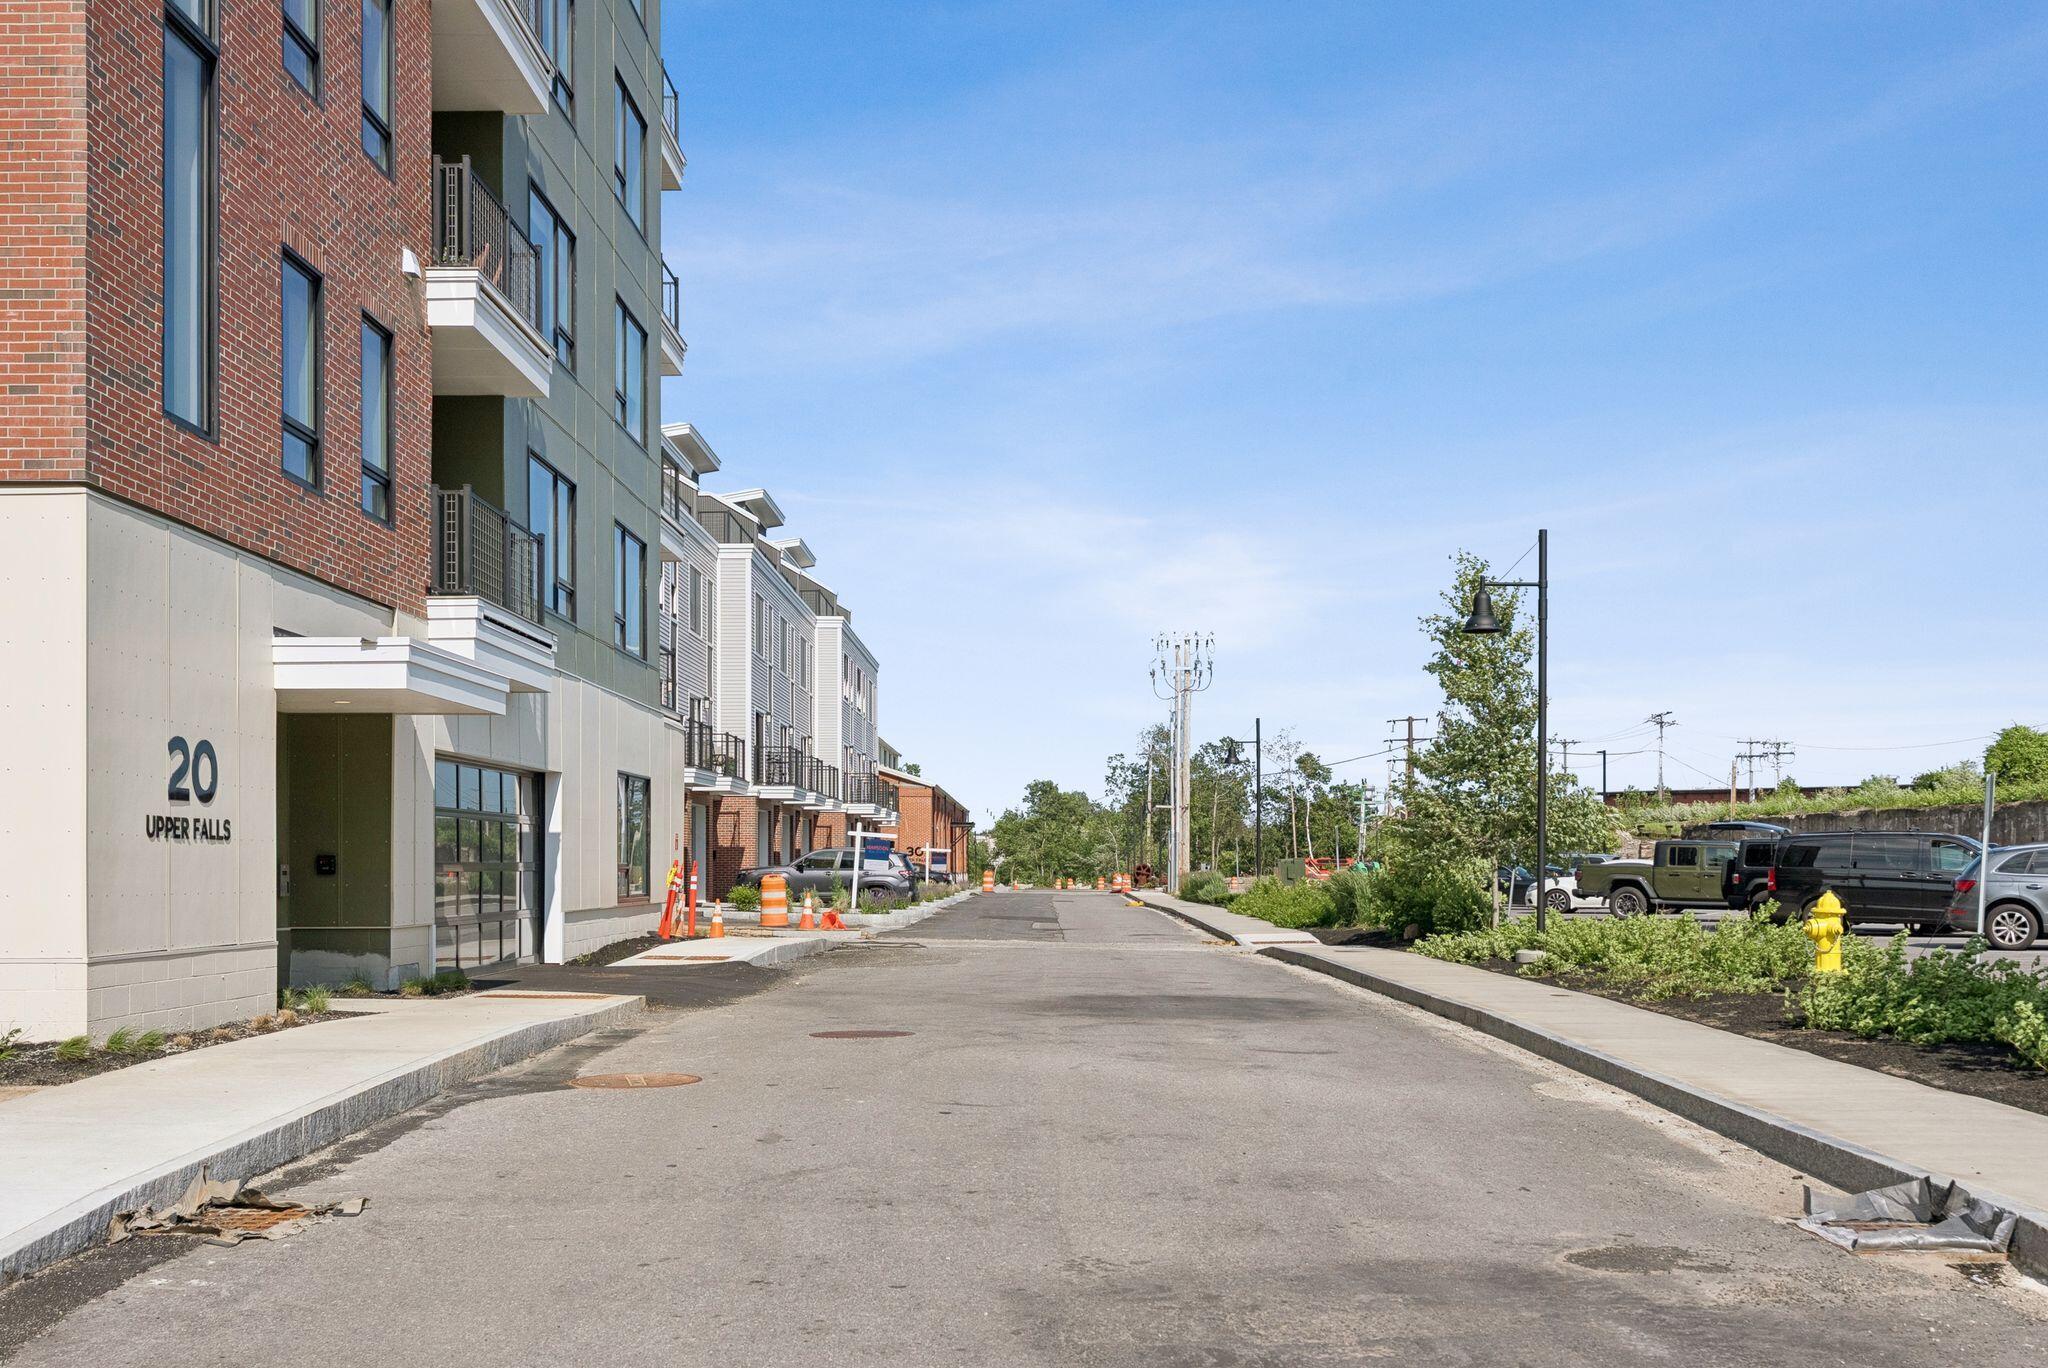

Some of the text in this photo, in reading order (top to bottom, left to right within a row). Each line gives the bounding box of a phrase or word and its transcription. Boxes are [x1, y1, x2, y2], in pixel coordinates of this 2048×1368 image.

[168, 736, 218, 803] 20
[146, 815, 231, 841] UPPER FALLS
